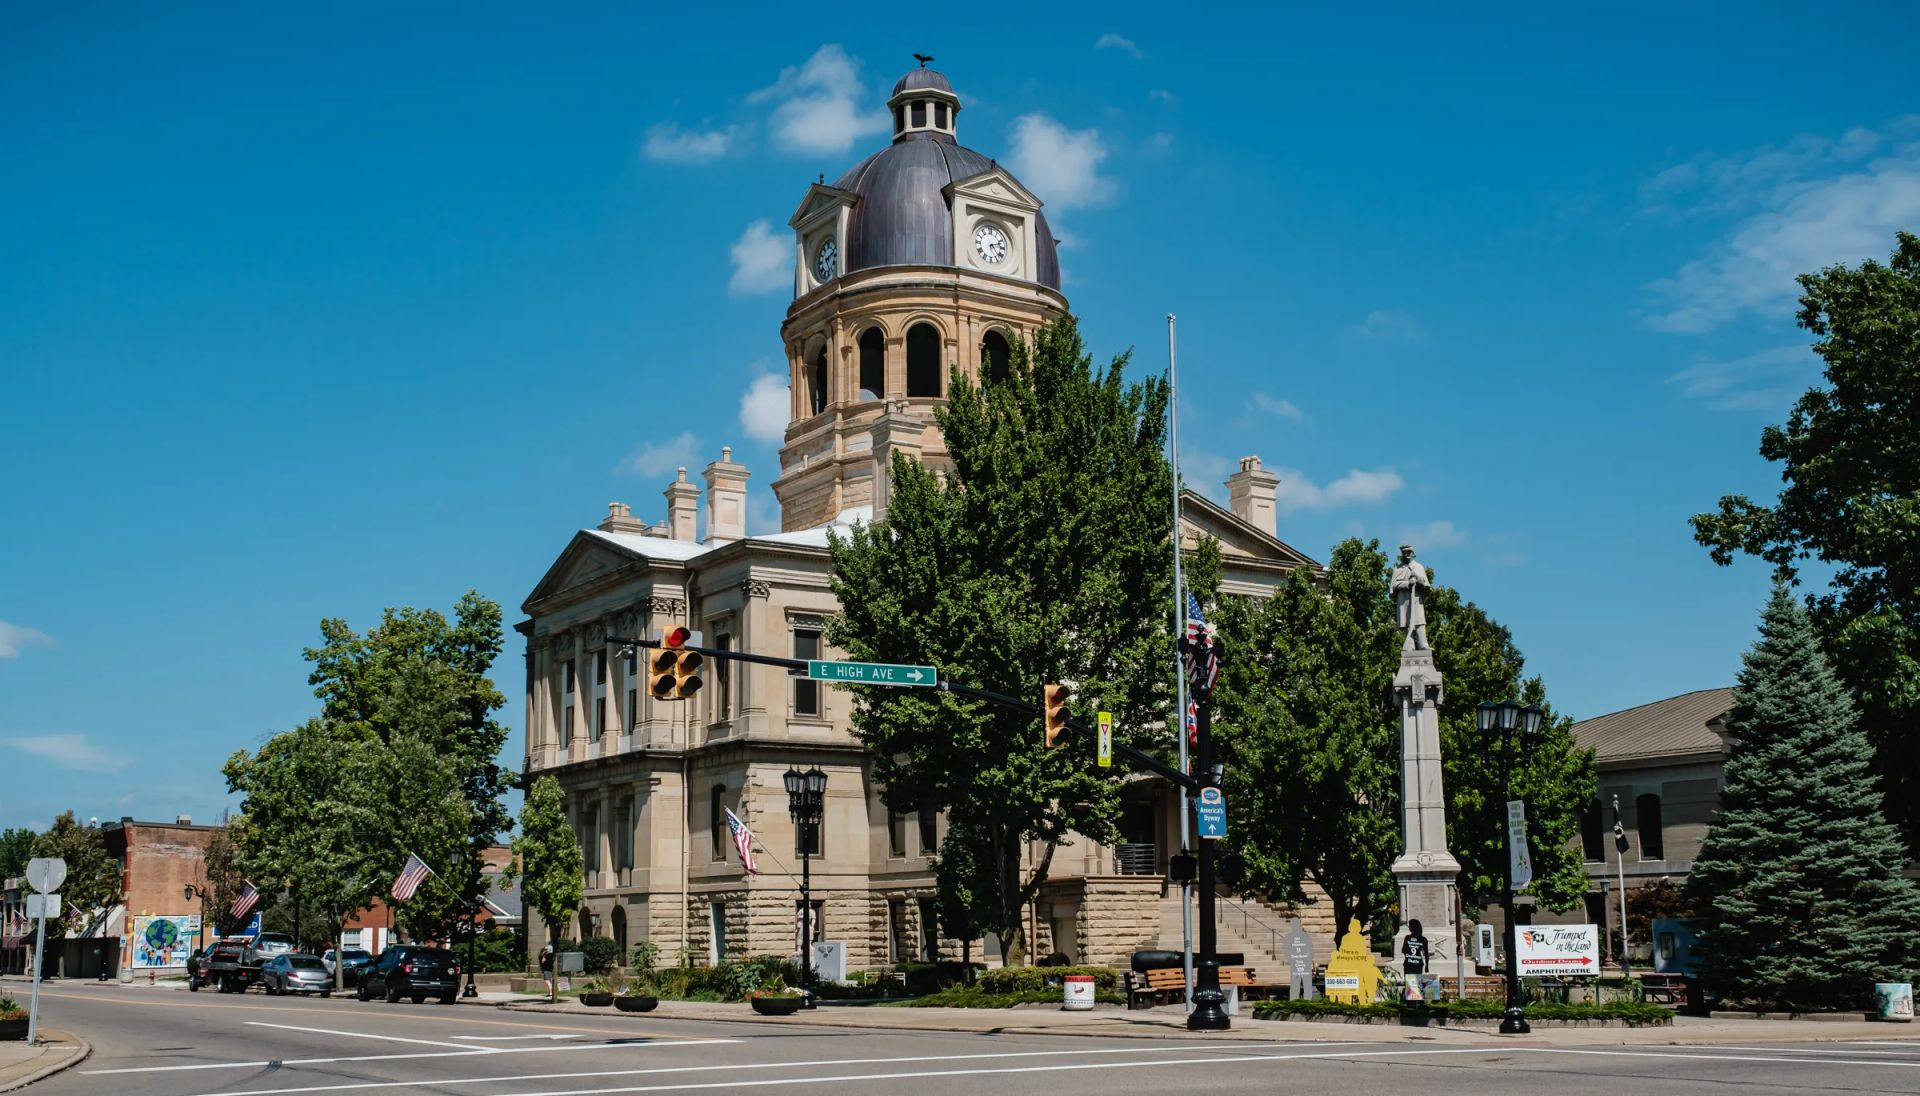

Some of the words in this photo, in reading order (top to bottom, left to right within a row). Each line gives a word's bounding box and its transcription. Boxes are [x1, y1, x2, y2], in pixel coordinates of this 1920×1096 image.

[821, 665, 828, 676] E
[837, 666, 863, 678] HIGH
[872, 668, 894, 680] AVE
[1204, 814, 1220, 822] Byway
[1546, 929, 1586, 945] Trumpet
[1410, 947, 1417, 956] 9
[1556, 943, 1563, 952] in
[1565, 941, 1574, 952] the
[1572, 940, 1592, 953] Land
